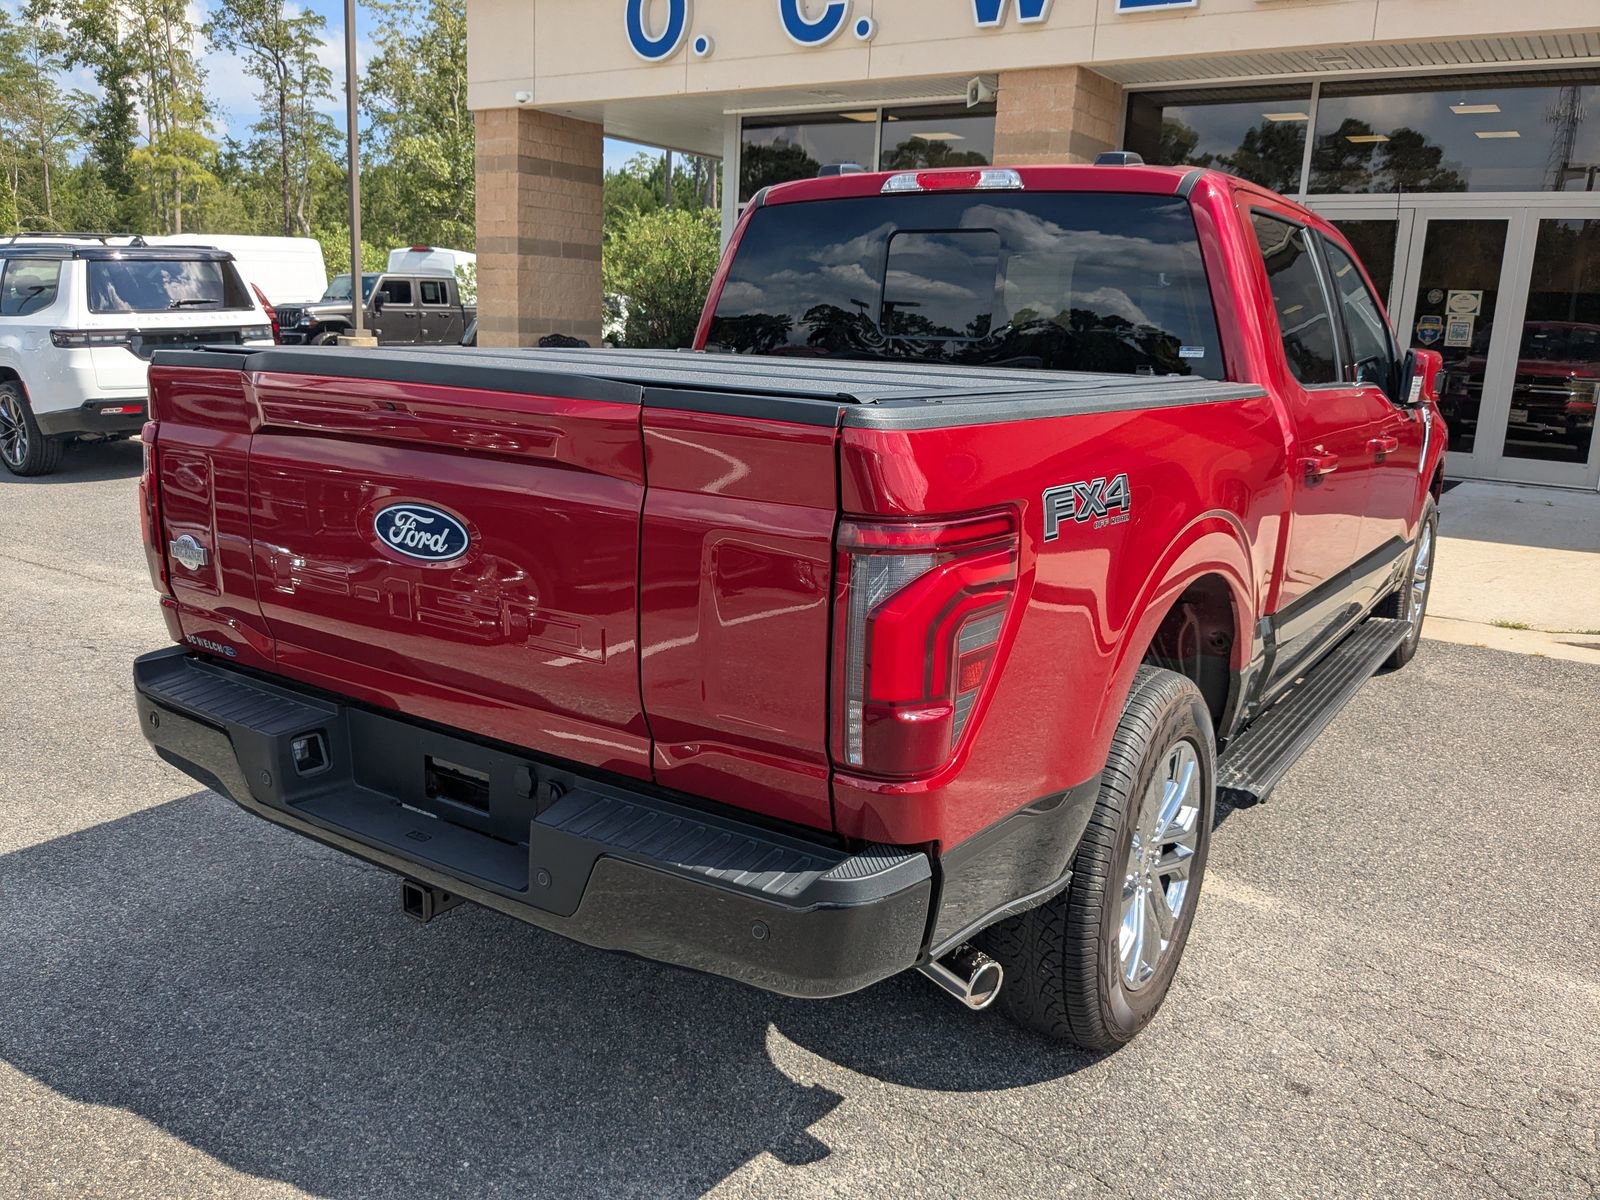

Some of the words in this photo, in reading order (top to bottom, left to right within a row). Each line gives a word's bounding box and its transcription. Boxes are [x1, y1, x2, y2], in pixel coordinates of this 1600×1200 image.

[1042, 473, 1130, 543] FX4
[389, 511, 450, 553] Ford
[196, 637, 224, 653] WELCH
